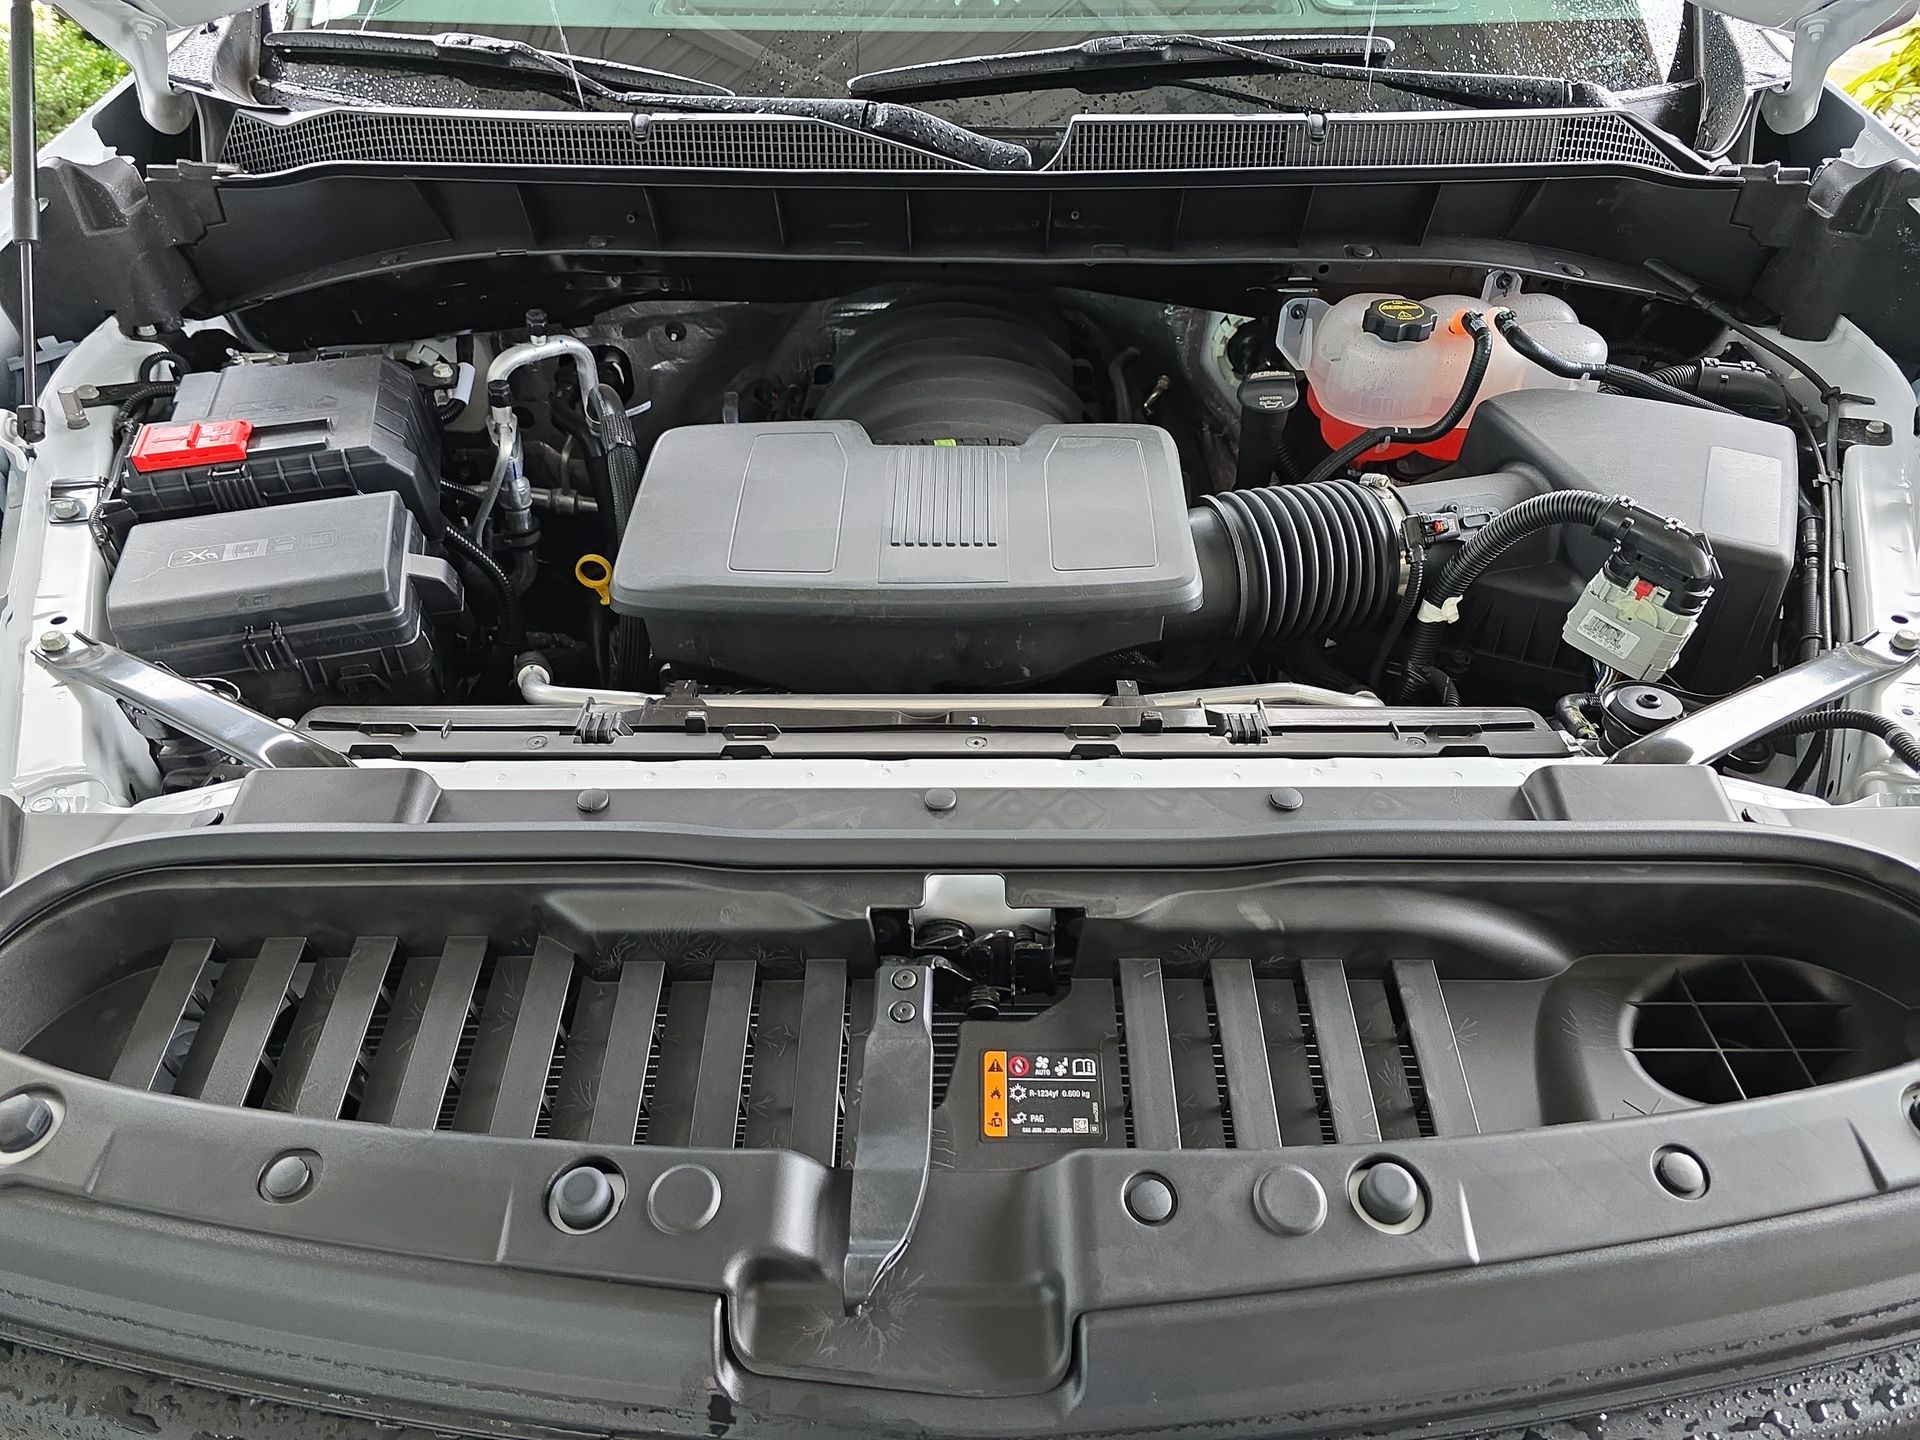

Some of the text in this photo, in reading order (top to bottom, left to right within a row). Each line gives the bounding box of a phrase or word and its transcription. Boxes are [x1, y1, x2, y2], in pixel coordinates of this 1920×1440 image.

[1029, 1089, 1091, 1099] R-1234yf 0.600 kg
[1029, 1114, 1045, 1123] PAG
